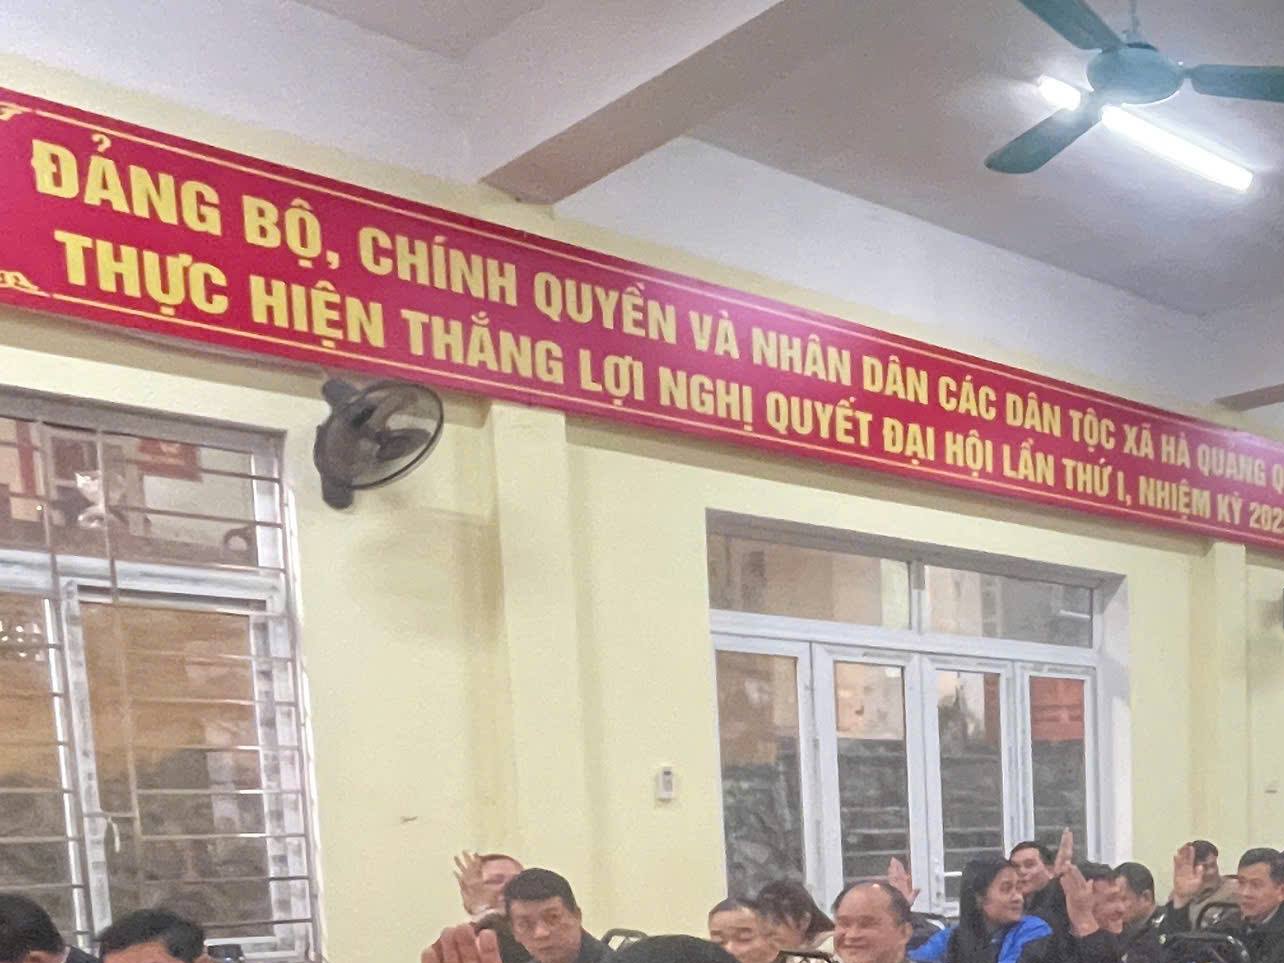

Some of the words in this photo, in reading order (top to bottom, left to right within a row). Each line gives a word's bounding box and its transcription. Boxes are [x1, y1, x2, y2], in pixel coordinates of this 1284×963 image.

[30, 133, 222, 237] ĐẢNG
[242, 195, 340, 270] BỘ,
[358, 226, 518, 307] CHÍNH
[533, 271, 677, 345] QUYỀN
[689, 309, 740, 360] VÀ
[752, 327, 852, 386] NHÂN
[862, 355, 929, 405] DÂN
[938, 374, 997, 421] CÁC
[1005, 391, 1062, 438] DÂN
[1069, 407, 1116, 453] TỘC
[1123, 423, 1155, 460] XÃ
[1161, 431, 1191, 469] HÀ
[54, 229, 229, 316] THỰC
[250, 274, 385, 348] HIỆN
[401, 309, 564, 385] THẮNG
[579, 348, 645, 406] LỢI
[658, 366, 753, 432] NGHỊ
[766, 391, 873, 448] QUYẾT
[882, 416, 935, 465] ĐẠI
[945, 429, 994, 478] HỘI
[1003, 437, 1055, 487] LẦN
[1062, 457, 1113, 497] THỨ
[1117, 471, 1132, 506] I,
[1139, 475, 1211, 520] NHIỆM
[1216, 491, 1243, 525] KỲ
